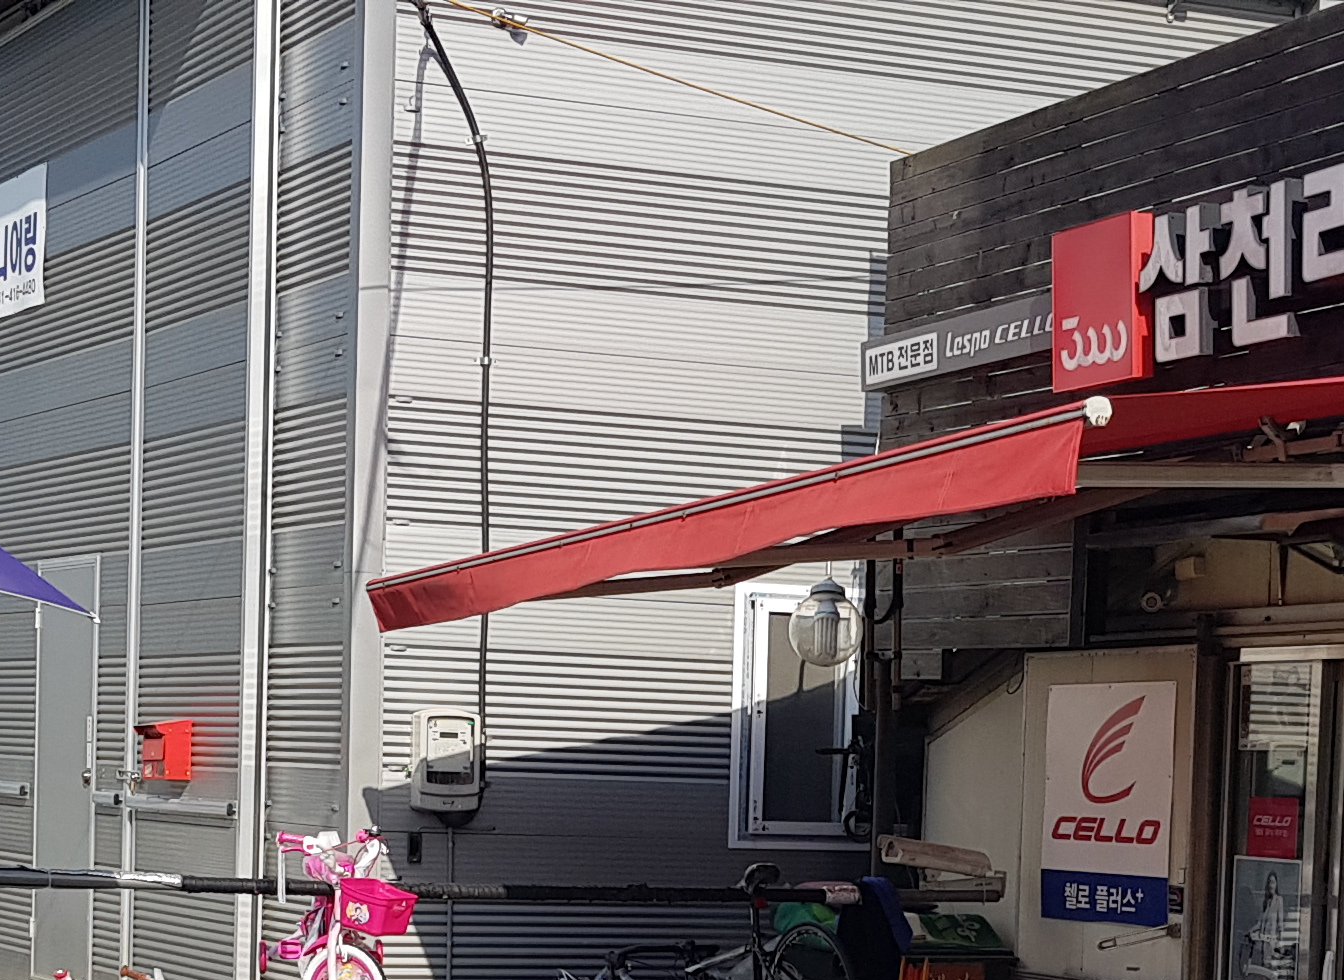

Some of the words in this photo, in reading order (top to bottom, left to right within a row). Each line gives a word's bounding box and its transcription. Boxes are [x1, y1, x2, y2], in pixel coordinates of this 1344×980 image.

[868, 351, 895, 377] MTB
[897, 337, 934, 371] 전문점
[945, 326, 990, 358] Lespo
[1051, 816, 1161, 845] CELLO
[1253, 815, 1292, 827] CELLO
[1064, 882, 1091, 910] 첼로
